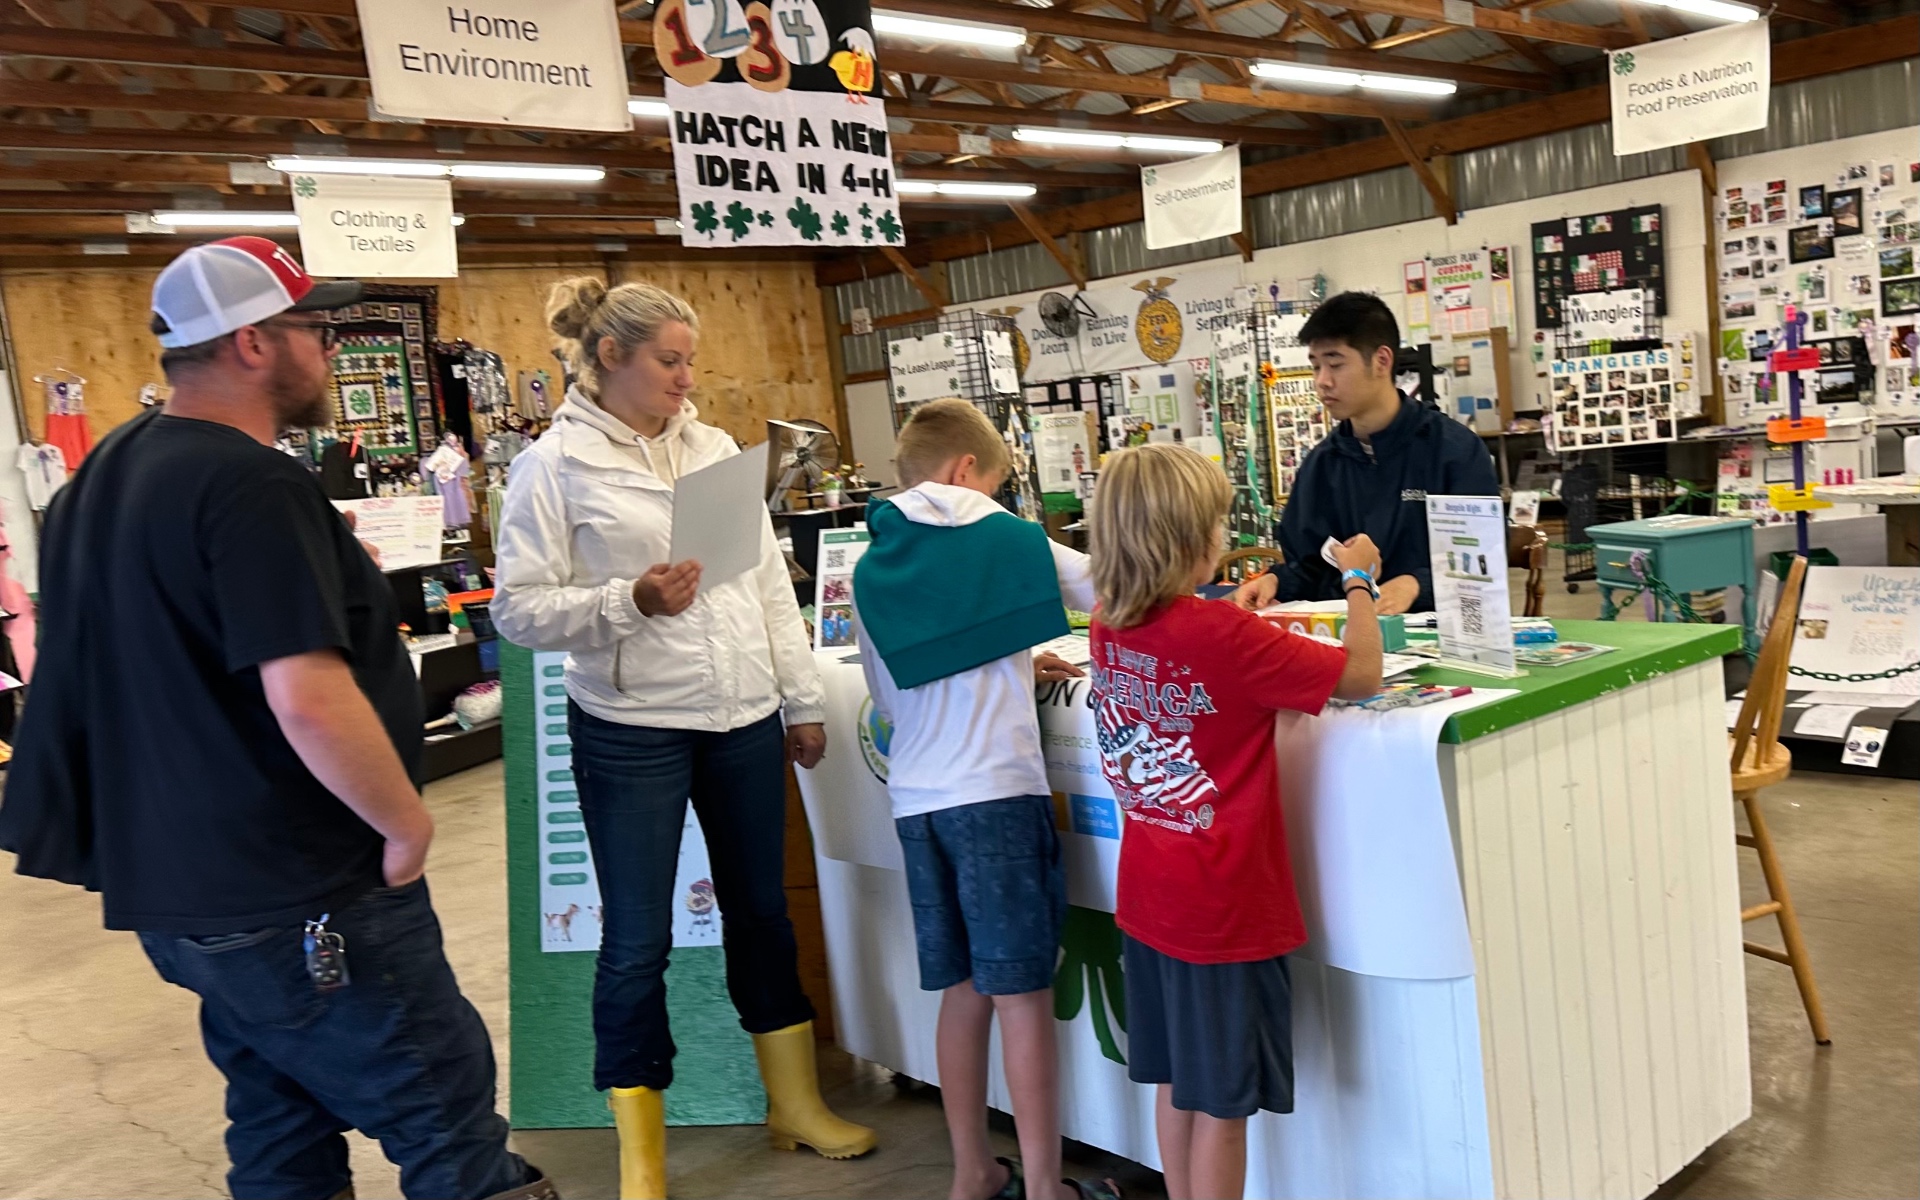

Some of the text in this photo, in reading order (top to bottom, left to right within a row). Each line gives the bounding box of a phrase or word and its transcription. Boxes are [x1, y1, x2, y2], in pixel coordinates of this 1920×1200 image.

[447, 6, 540, 42] Home
[665, 0, 815, 82] 1 2 3 4
[399, 43, 593, 88] Environment
[1628, 60, 1753, 98] Foods & Nutrition
[1626, 80, 1760, 118] Food Preservation
[674, 110, 888, 157] HATCH A NEW
[694, 154, 892, 198] IDEA IN 4-H
[1154, 176, 1236, 207] Self-Determined
[330, 210, 427, 232] Clothing &
[345, 235, 416, 252] Textiles
[1437, 263, 1473, 276] CUSTOM
[1185, 299, 1223, 315] Living
[1572, 304, 1643, 324] Wranglers
[1086, 314, 1129, 331] Earning
[1092, 332, 1127, 347] to Live
[891, 359, 956, 376] The Leash League
[1551, 352, 1669, 374] WRANGLERS
[1105, 642, 1116, 665] I
[1090, 658, 1218, 721] MERICA
